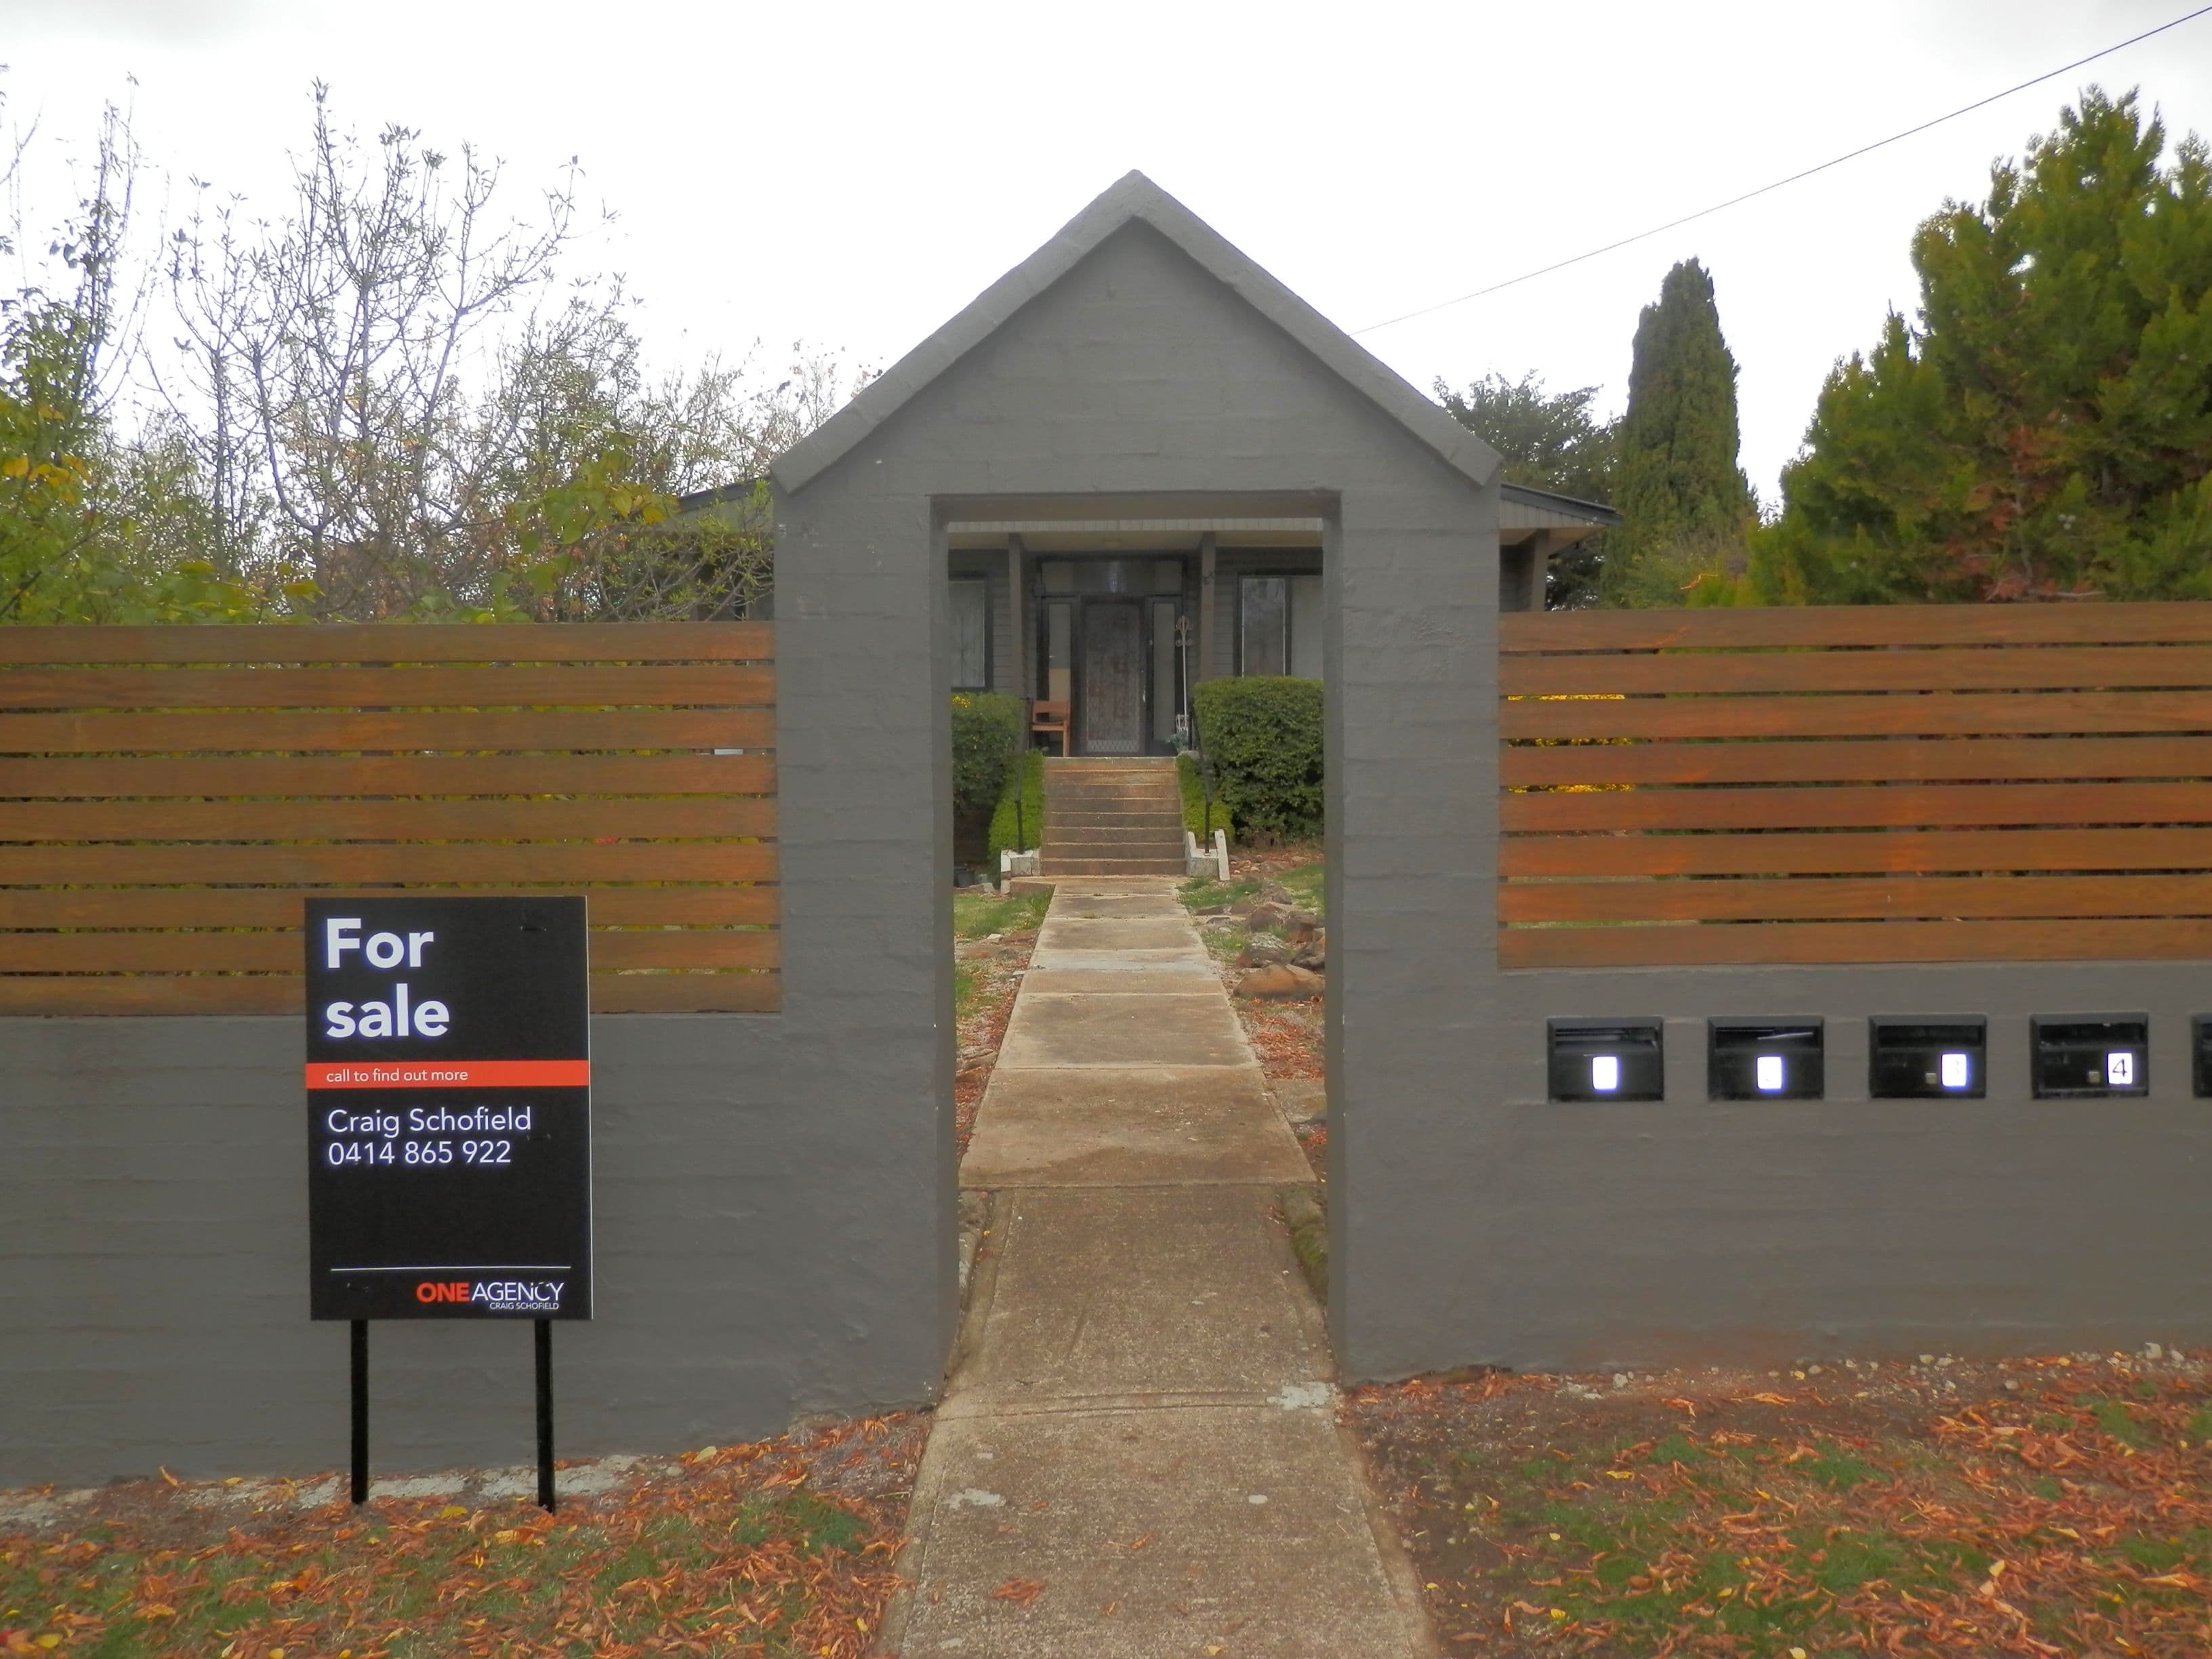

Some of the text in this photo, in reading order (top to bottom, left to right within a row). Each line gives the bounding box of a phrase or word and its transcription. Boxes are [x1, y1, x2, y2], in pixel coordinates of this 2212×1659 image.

[327, 918, 434, 968] For
[326, 983, 450, 1038] sale
[326, 1068, 468, 1082] call to find out more
[2112, 1059, 2127, 1078] 4
[328, 1106, 531, 1139] Craig Schofield
[329, 1141, 512, 1165] 0414 865 922
[489, 1302, 559, 1310] CRAIG SCHOFIELD
